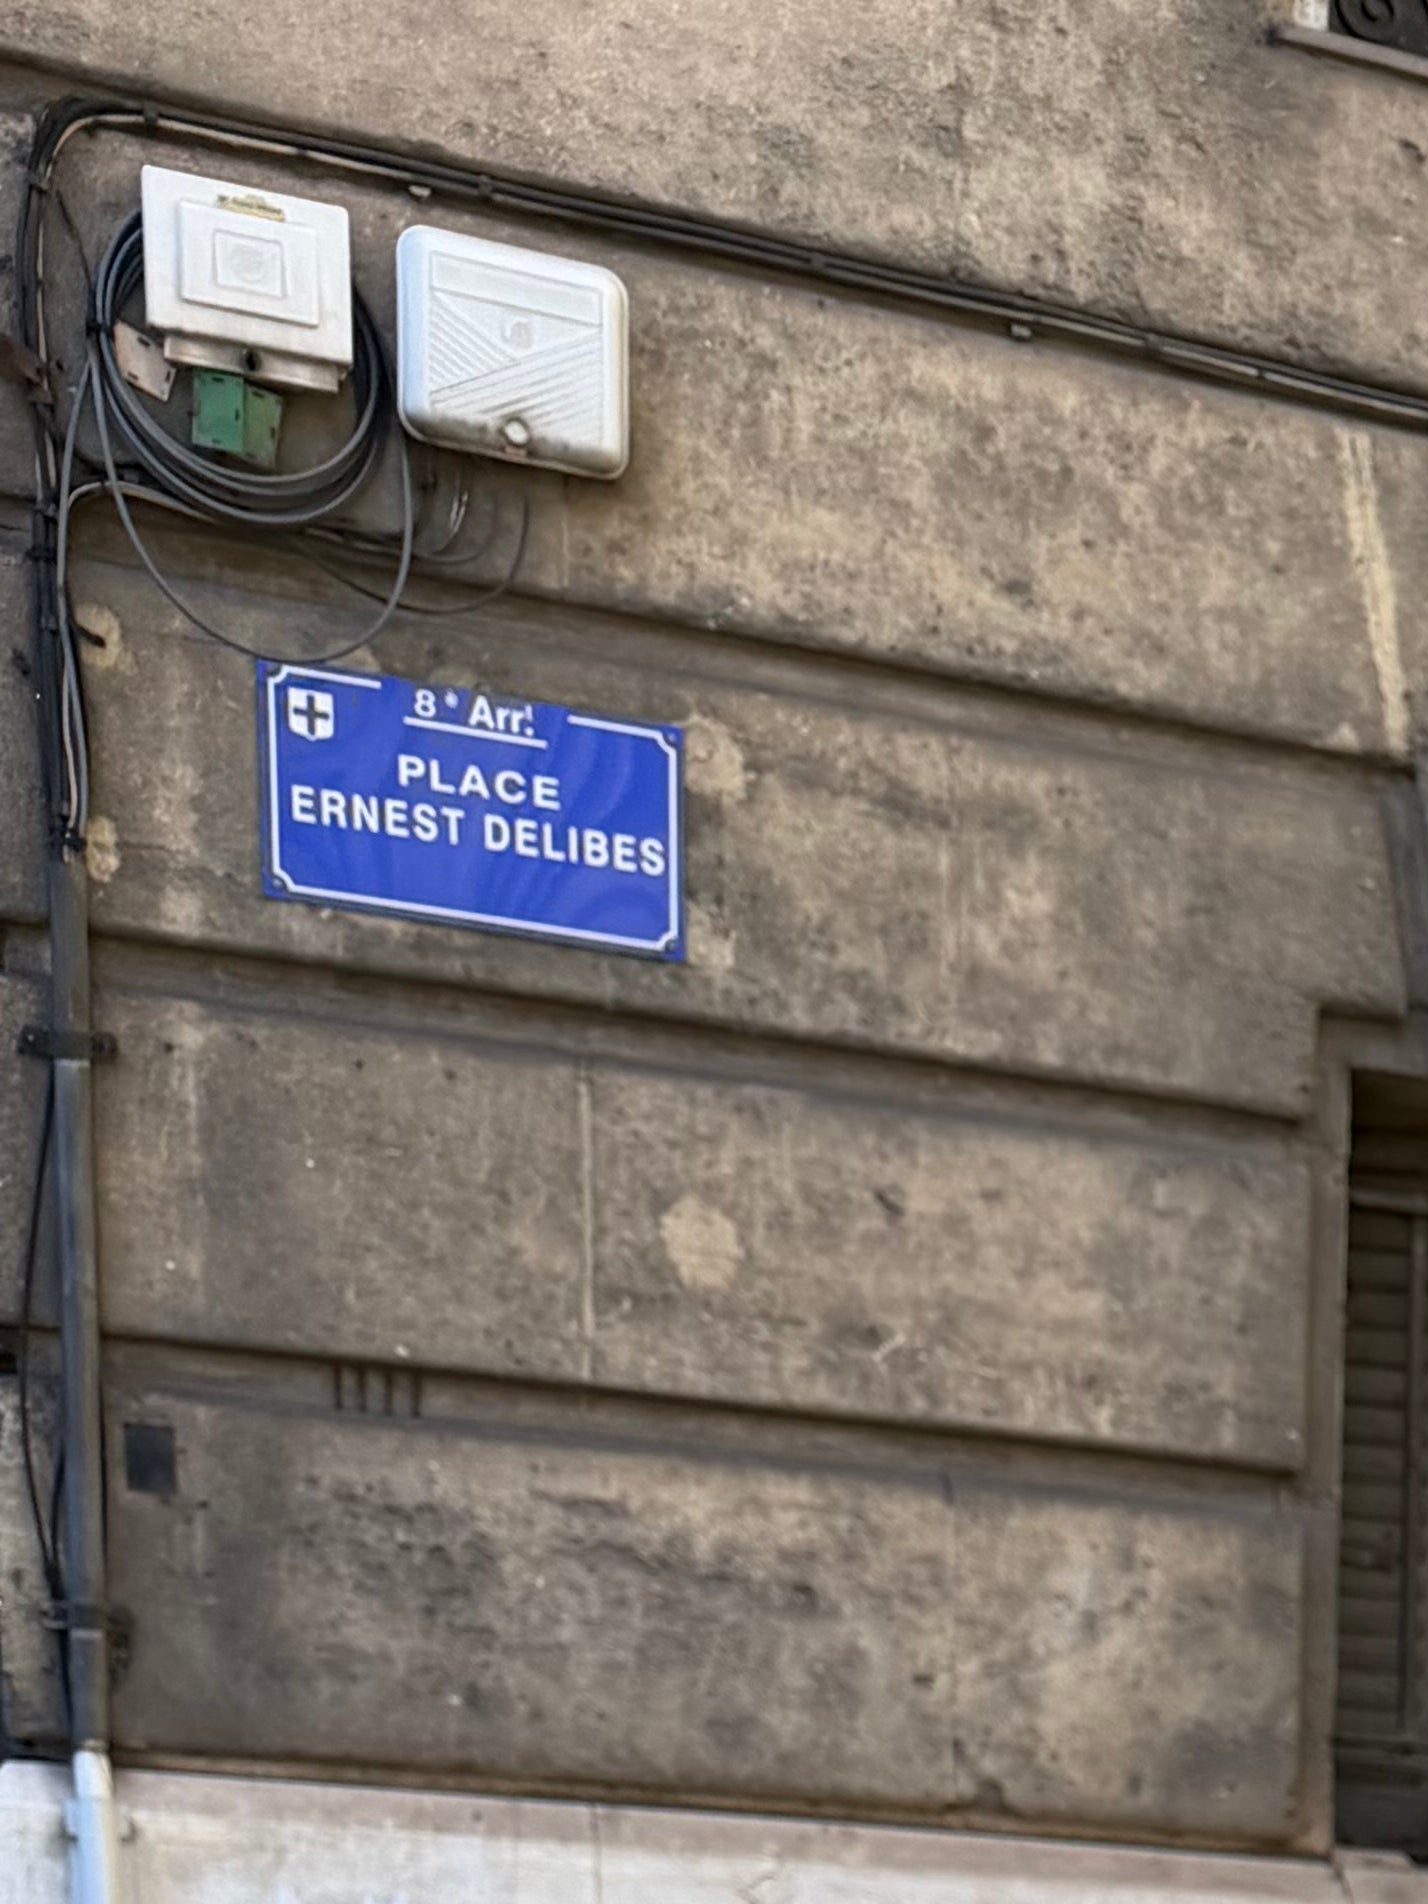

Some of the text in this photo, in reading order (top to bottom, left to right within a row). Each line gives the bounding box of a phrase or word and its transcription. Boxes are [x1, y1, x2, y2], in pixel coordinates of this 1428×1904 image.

[397, 754, 561, 811] PLACE
[290, 784, 666, 877] ERNEST DELIBES
